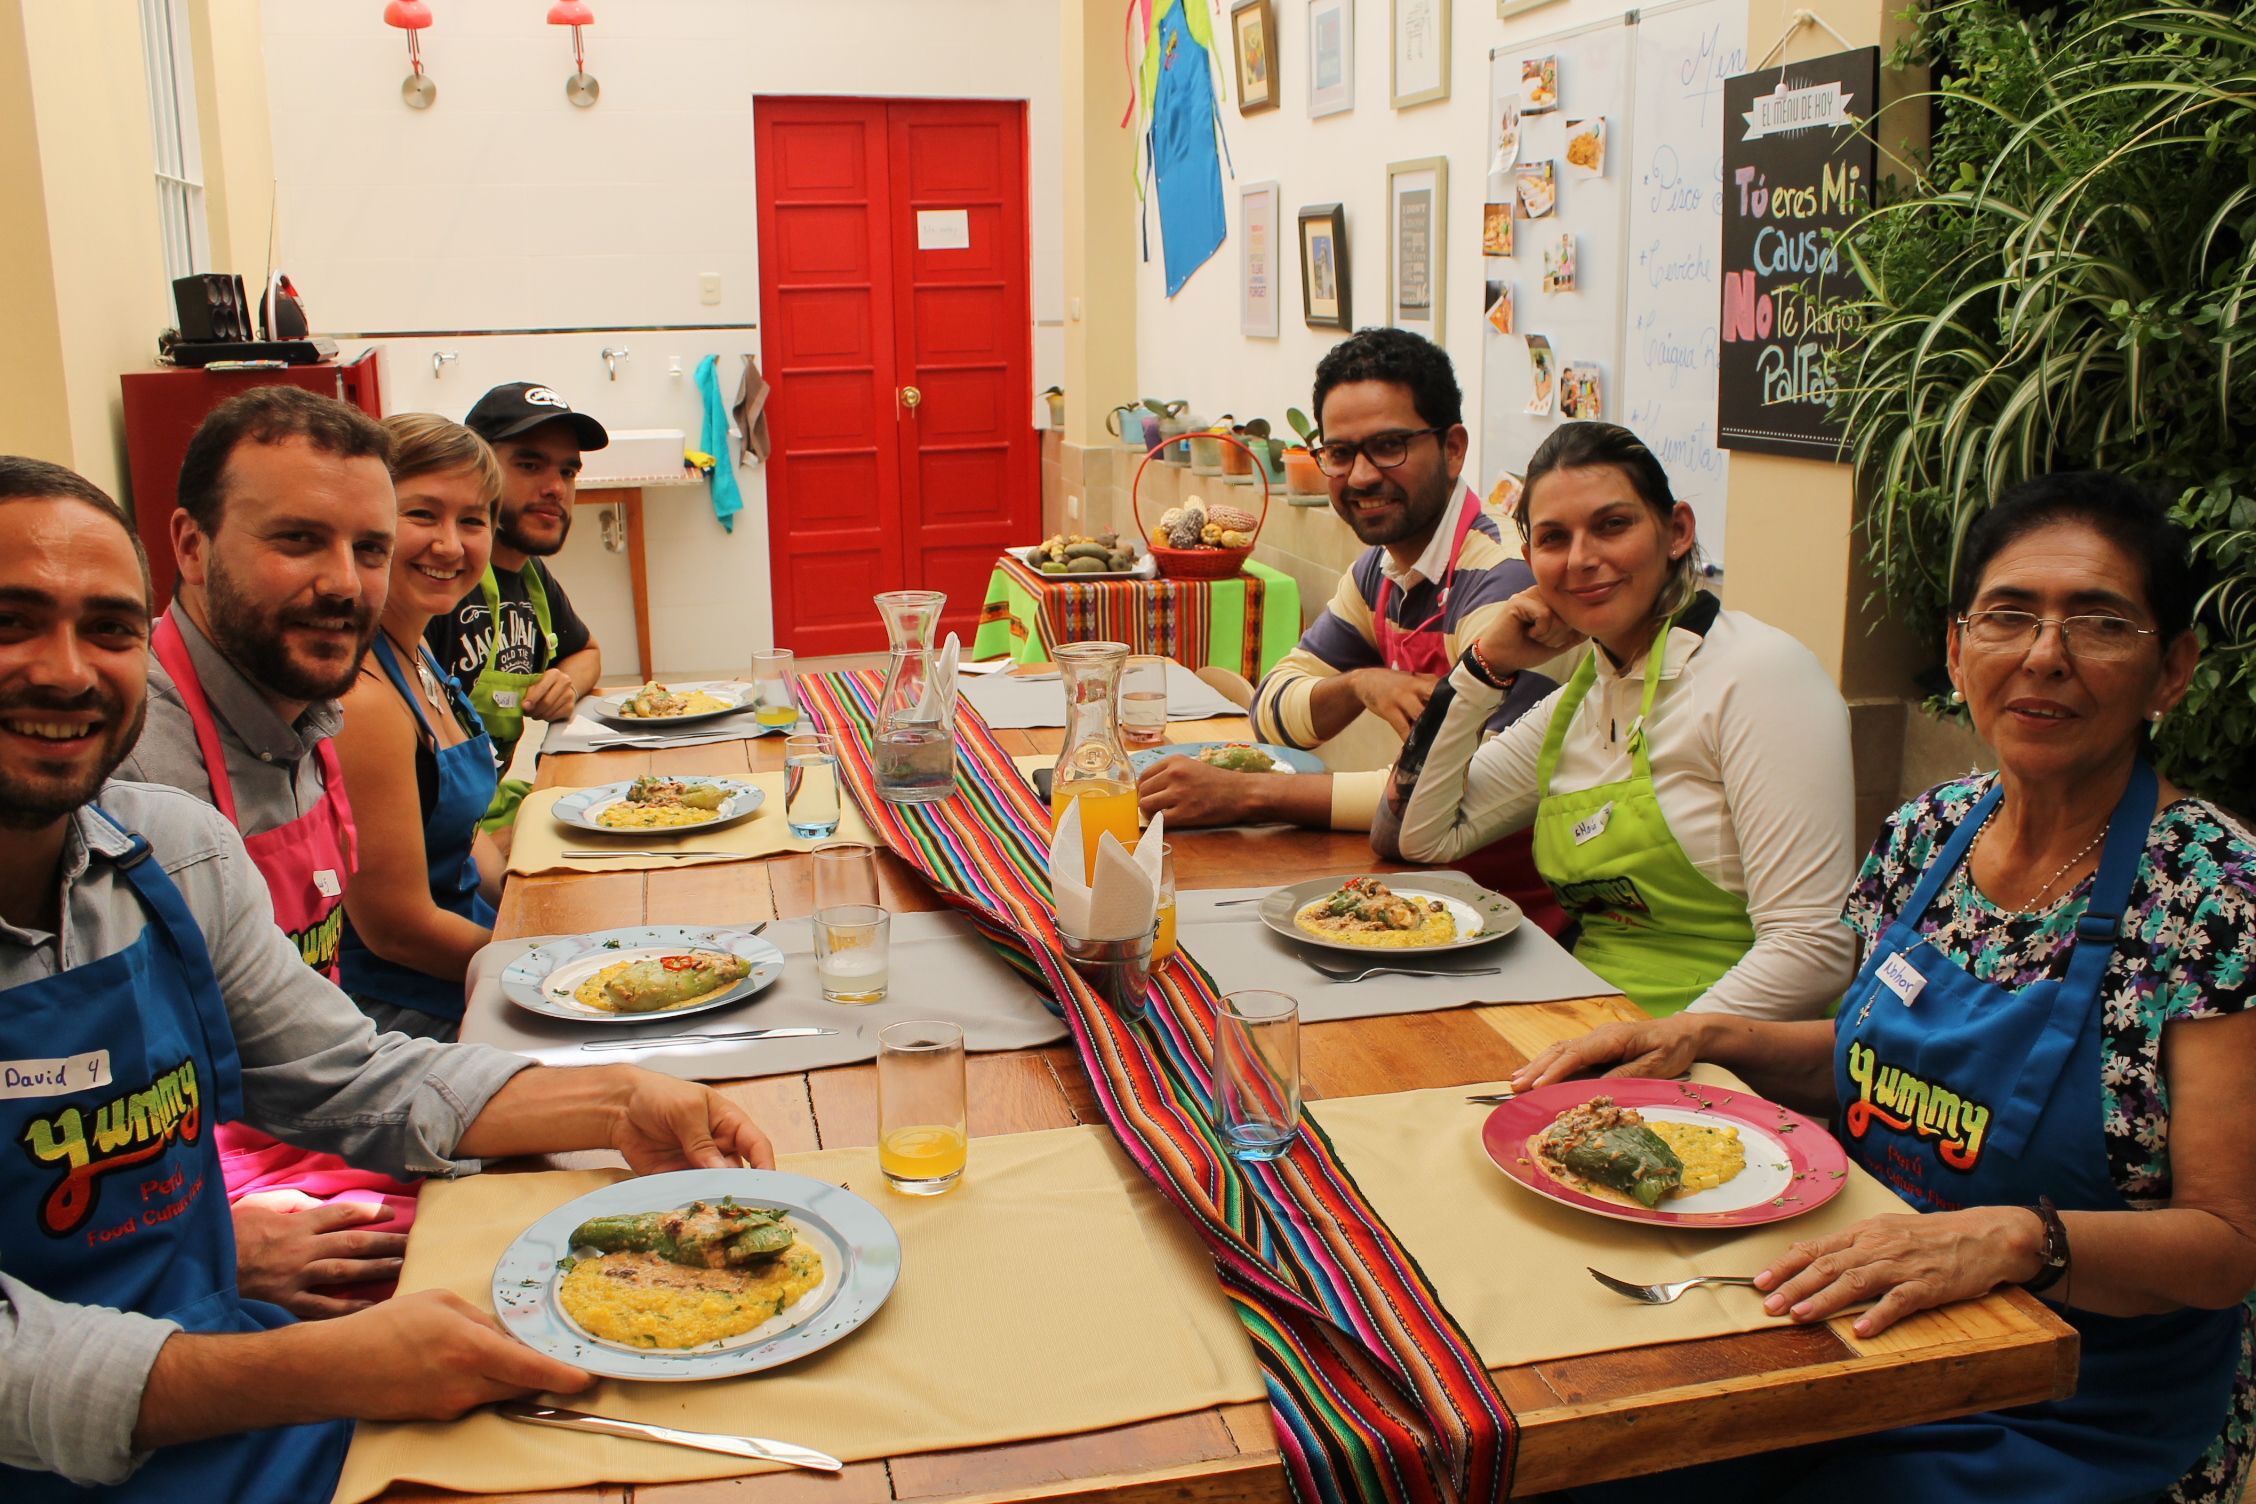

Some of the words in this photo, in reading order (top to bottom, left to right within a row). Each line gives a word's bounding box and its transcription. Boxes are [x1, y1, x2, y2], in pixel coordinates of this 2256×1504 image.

[1762, 103, 1771, 127] EL
[1801, 95, 1813, 119] DE
[1815, 91, 1833, 117] HOY
[1772, 186, 1818, 219] eres
[5, 1064, 67, 1087] David
